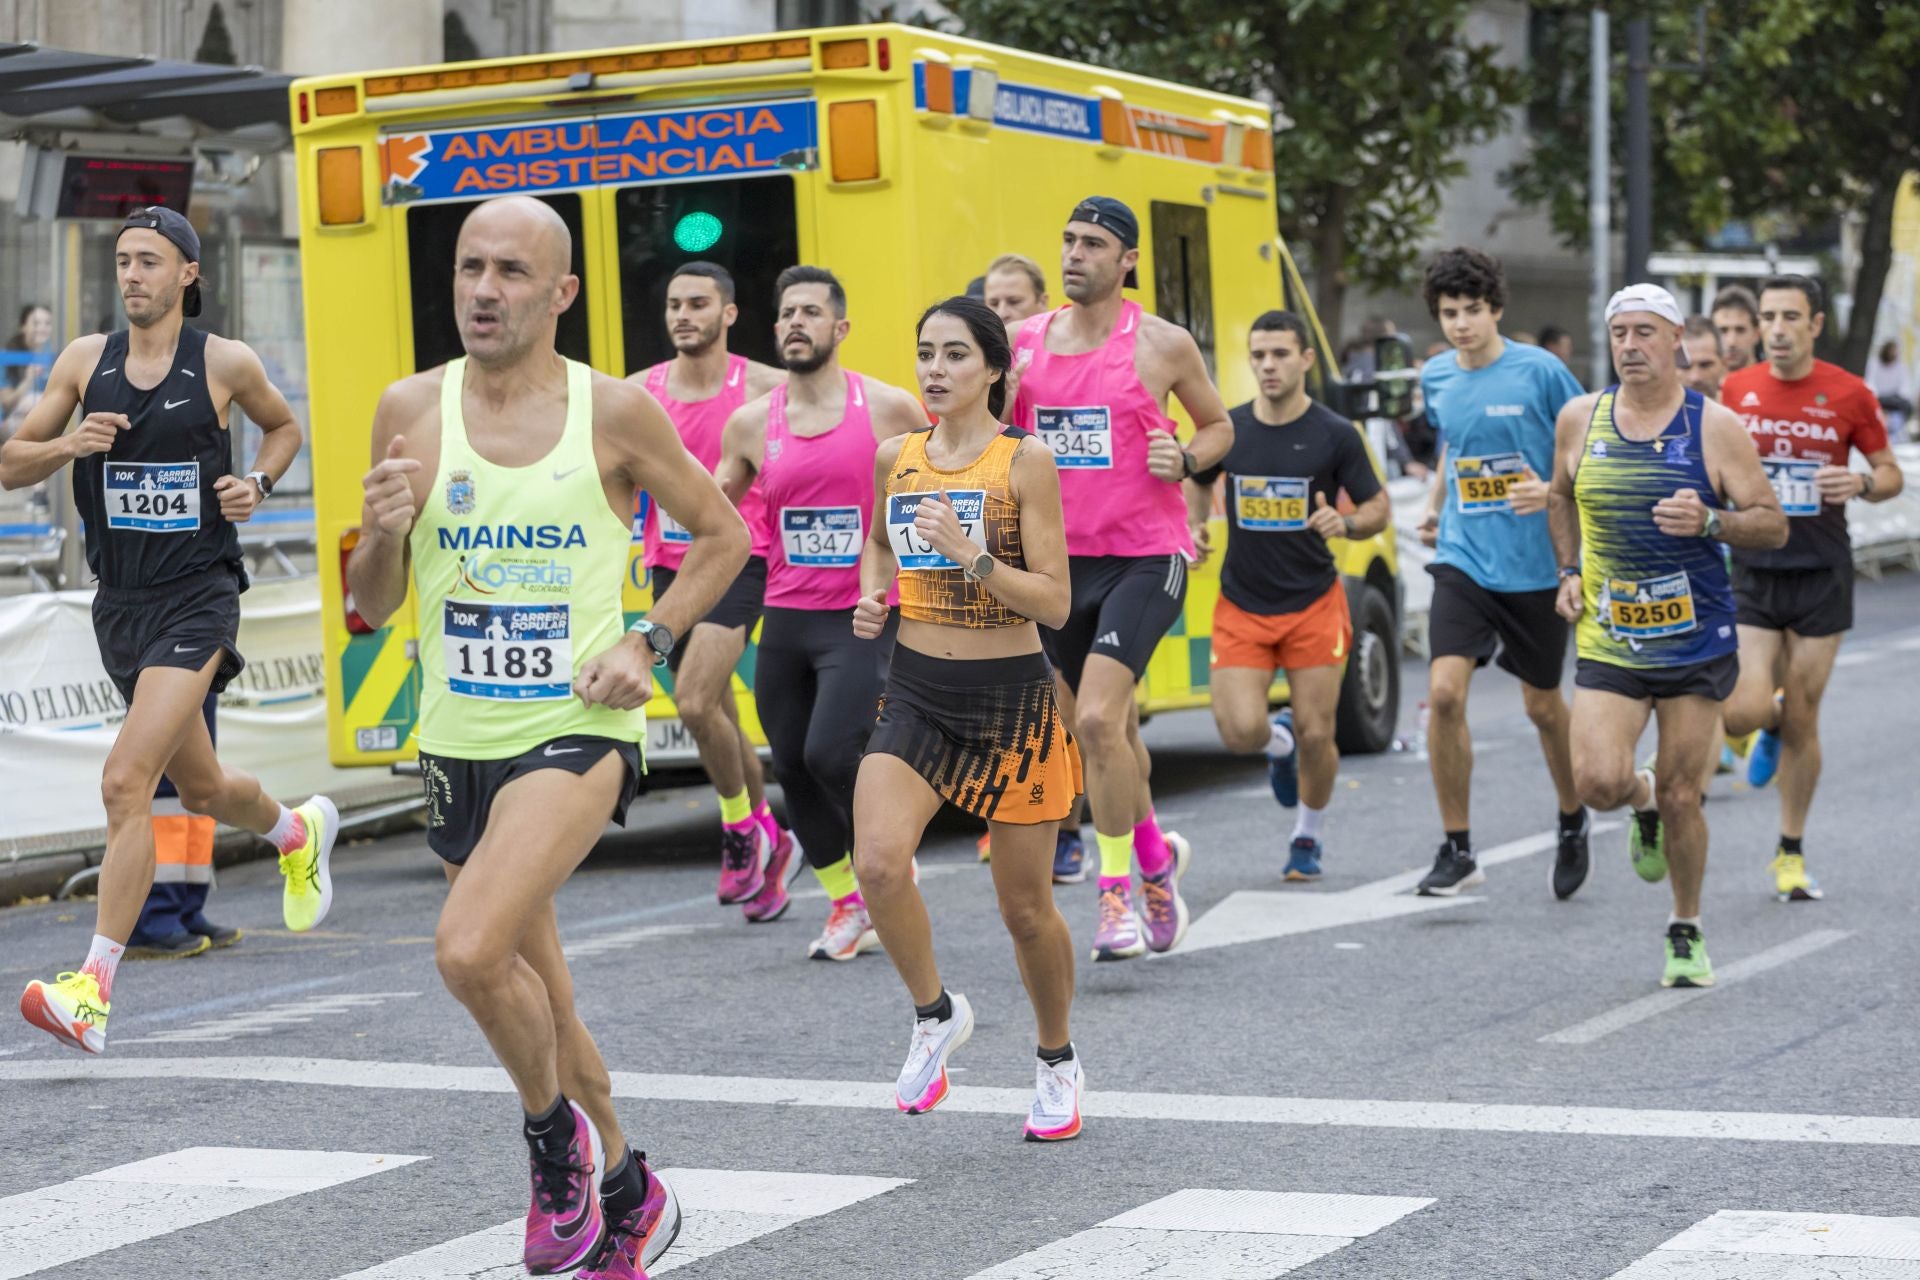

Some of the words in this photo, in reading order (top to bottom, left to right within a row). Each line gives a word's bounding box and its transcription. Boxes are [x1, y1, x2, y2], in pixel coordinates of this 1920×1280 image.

[442, 109, 783, 162] AMBULANCIA
[453, 142, 777, 193] ASISTENCIAL
[1042, 433, 1103, 455] 1345
[115, 471, 135, 481] 10K
[157, 475, 195, 483] POPULAR
[158, 469, 196, 478] CARRERA
[120, 493, 188, 516] 1204
[1245, 499, 1301, 518] 5316
[437, 525, 588, 550] MAINSA
[792, 532, 854, 553] 1347
[472, 558, 572, 588] Losada
[453, 612, 479, 626] 10K
[511, 612, 568, 623] CARRERA
[1619, 602, 1682, 624] 5250
[510, 620, 567, 630] POPULAR
[548, 629, 566, 638] DM
[459, 644, 553, 678] 1183
[276, 655, 325, 692] DIAR
[32, 687, 66, 721] EL
[360, 727, 394, 751] SP
